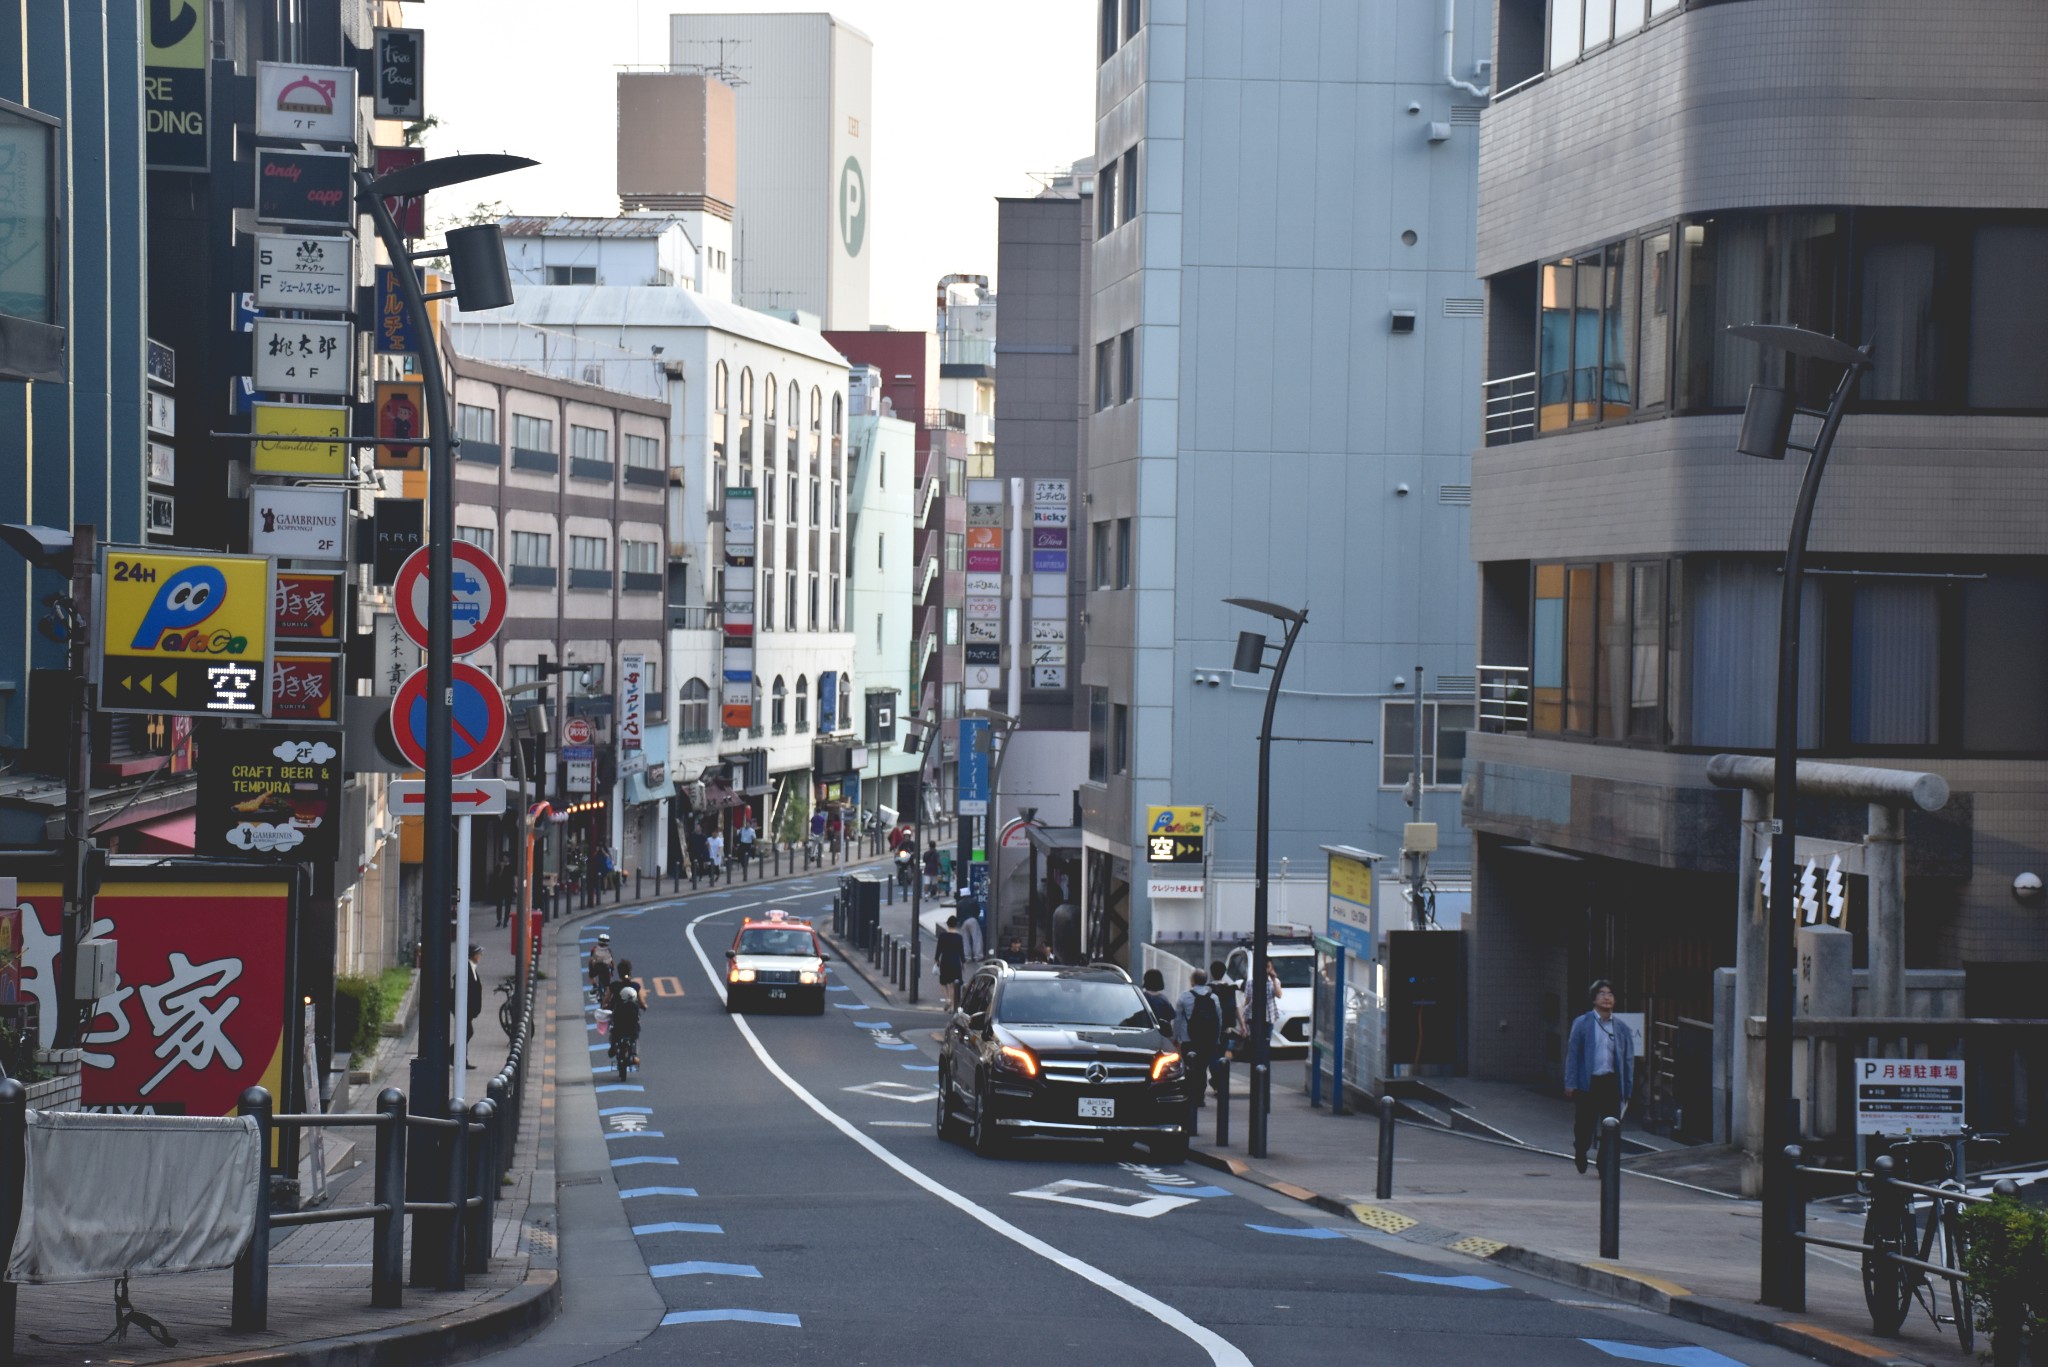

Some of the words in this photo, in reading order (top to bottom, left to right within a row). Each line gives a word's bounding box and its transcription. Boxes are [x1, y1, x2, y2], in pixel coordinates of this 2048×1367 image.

[847, 115, 860, 138] IHI
[307, 188, 343, 204] capp
[279, 280, 341, 295] ジェームスモンロー
[268, 333, 337, 360] 桃太郎
[276, 514, 336, 527] GAMBRINUS
[1034, 512, 1067, 523] Ricky
[318, 540, 334, 551] 2F
[113, 561, 156, 583] 24H
[969, 603, 997, 612] noble
[206, 662, 257, 710] 空
[297, 748, 313, 758] 2F
[231, 765, 274, 779] CRAFT
[280, 766, 314, 779] BEER
[321, 767, 329, 780] &
[232, 780, 291, 794] TEMPURA
[252, 832, 293, 840] GAMBRINUS
[1150, 836, 1174, 860] 空
[1865, 1062, 1877, 1079] P
[1882, 1064, 1958, 1080] 月極駐車場
